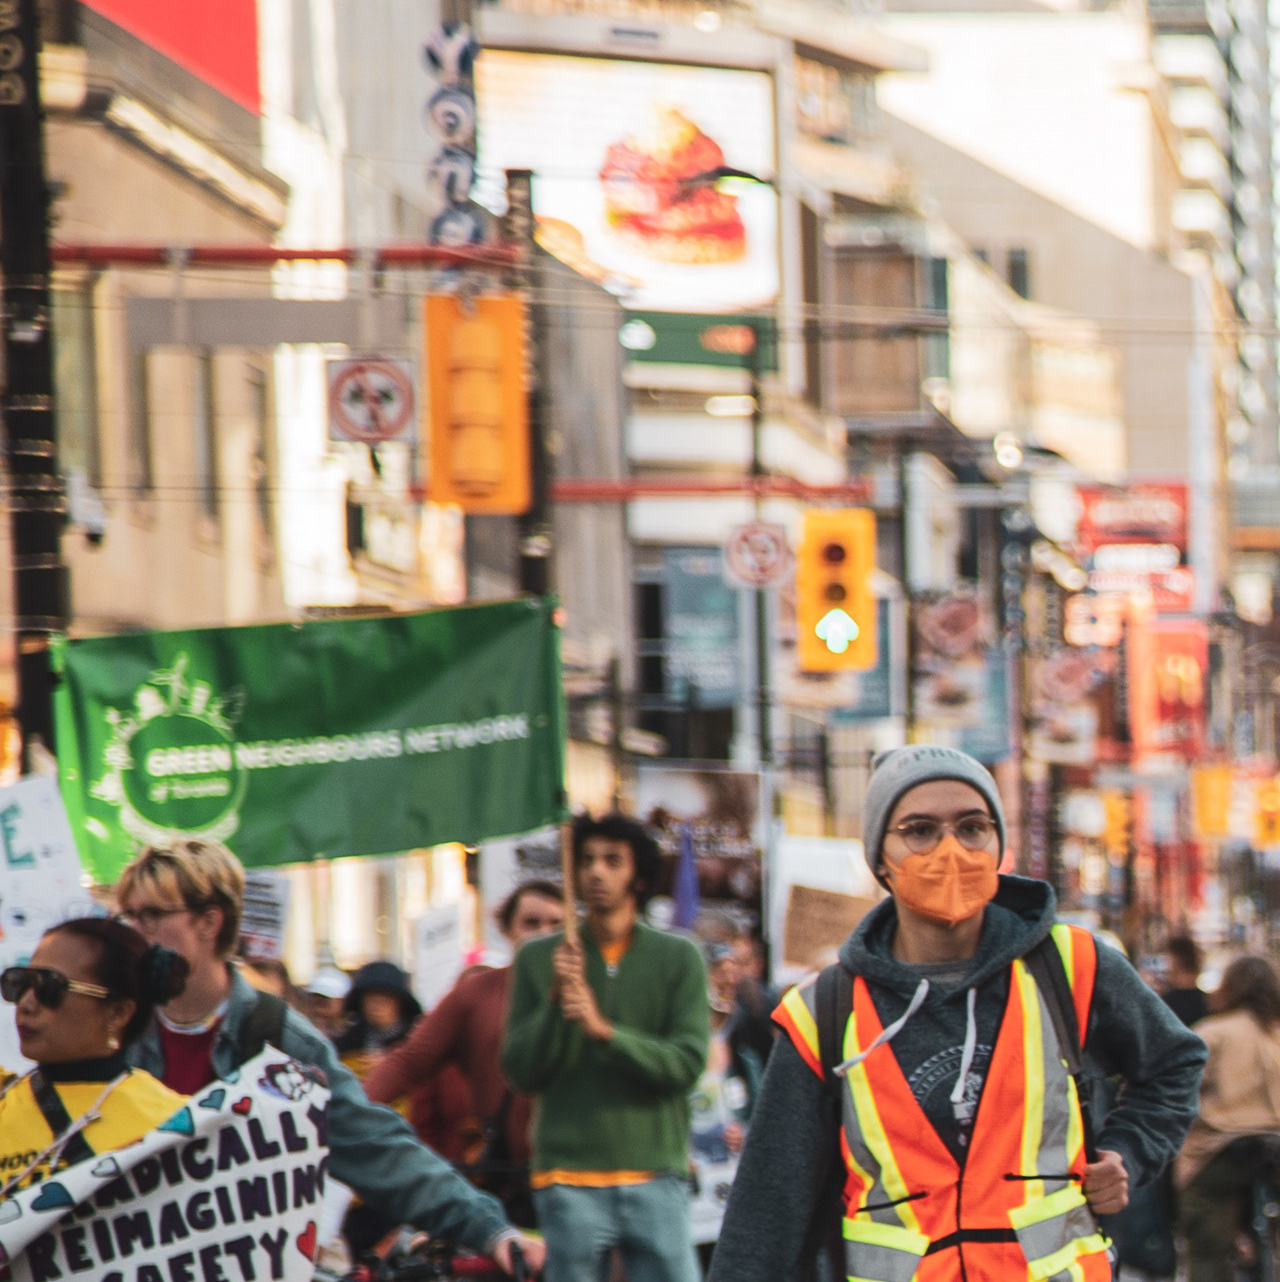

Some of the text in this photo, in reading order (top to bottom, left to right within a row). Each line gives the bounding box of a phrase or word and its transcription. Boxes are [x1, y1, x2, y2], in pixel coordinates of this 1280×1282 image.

[147, 712, 531, 776] GREEN NEIGHBOURS NETWORK
[58, 1103, 330, 1225] ADICALLY
